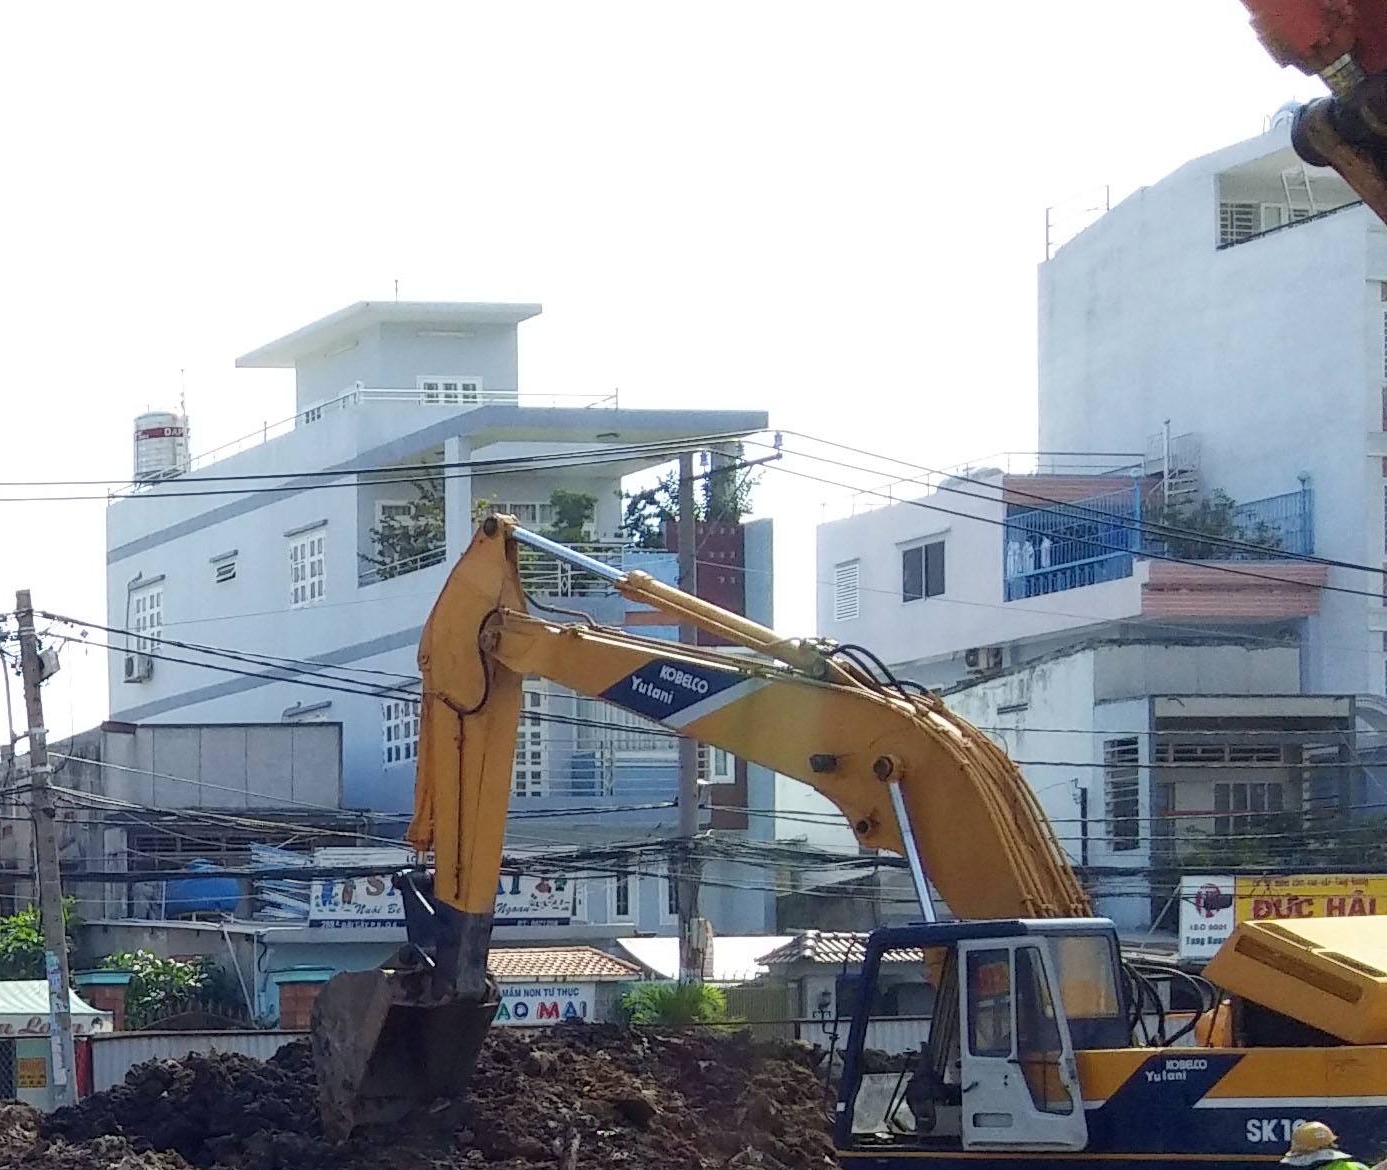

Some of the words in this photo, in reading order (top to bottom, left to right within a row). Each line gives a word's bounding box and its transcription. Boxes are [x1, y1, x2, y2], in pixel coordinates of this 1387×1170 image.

[659, 664, 709, 694] KOBELCO
[631, 675, 675, 704] Yutani
[524, 988, 542, 997] NON
[536, 1000, 588, 1020] MAI
[1165, 1058, 1208, 1070] KOBELCO
[1144, 1070, 1187, 1082] Yutani
